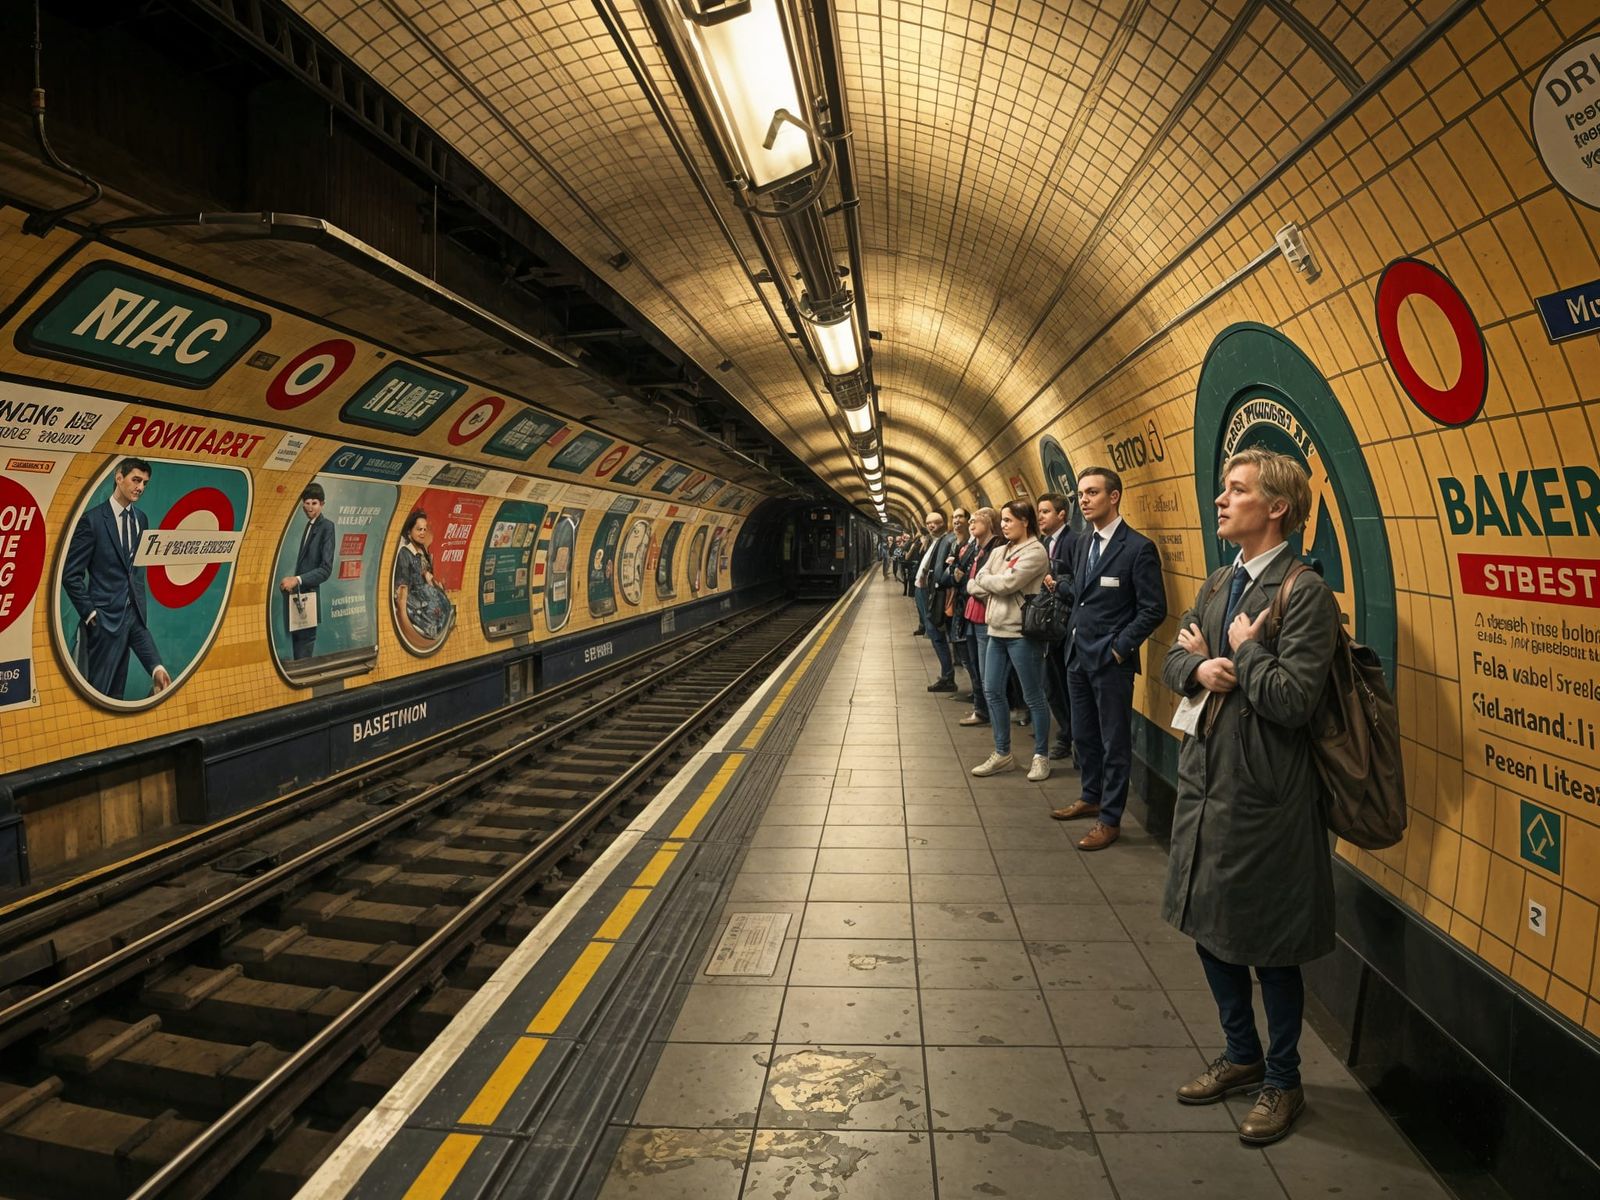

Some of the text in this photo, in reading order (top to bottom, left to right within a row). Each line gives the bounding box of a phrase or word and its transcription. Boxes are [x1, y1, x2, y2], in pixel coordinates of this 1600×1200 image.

[72, 287, 229, 365] NIAC
[1438, 465, 1600, 536] BAKER
[1530, 906, 1542, 927] 2
